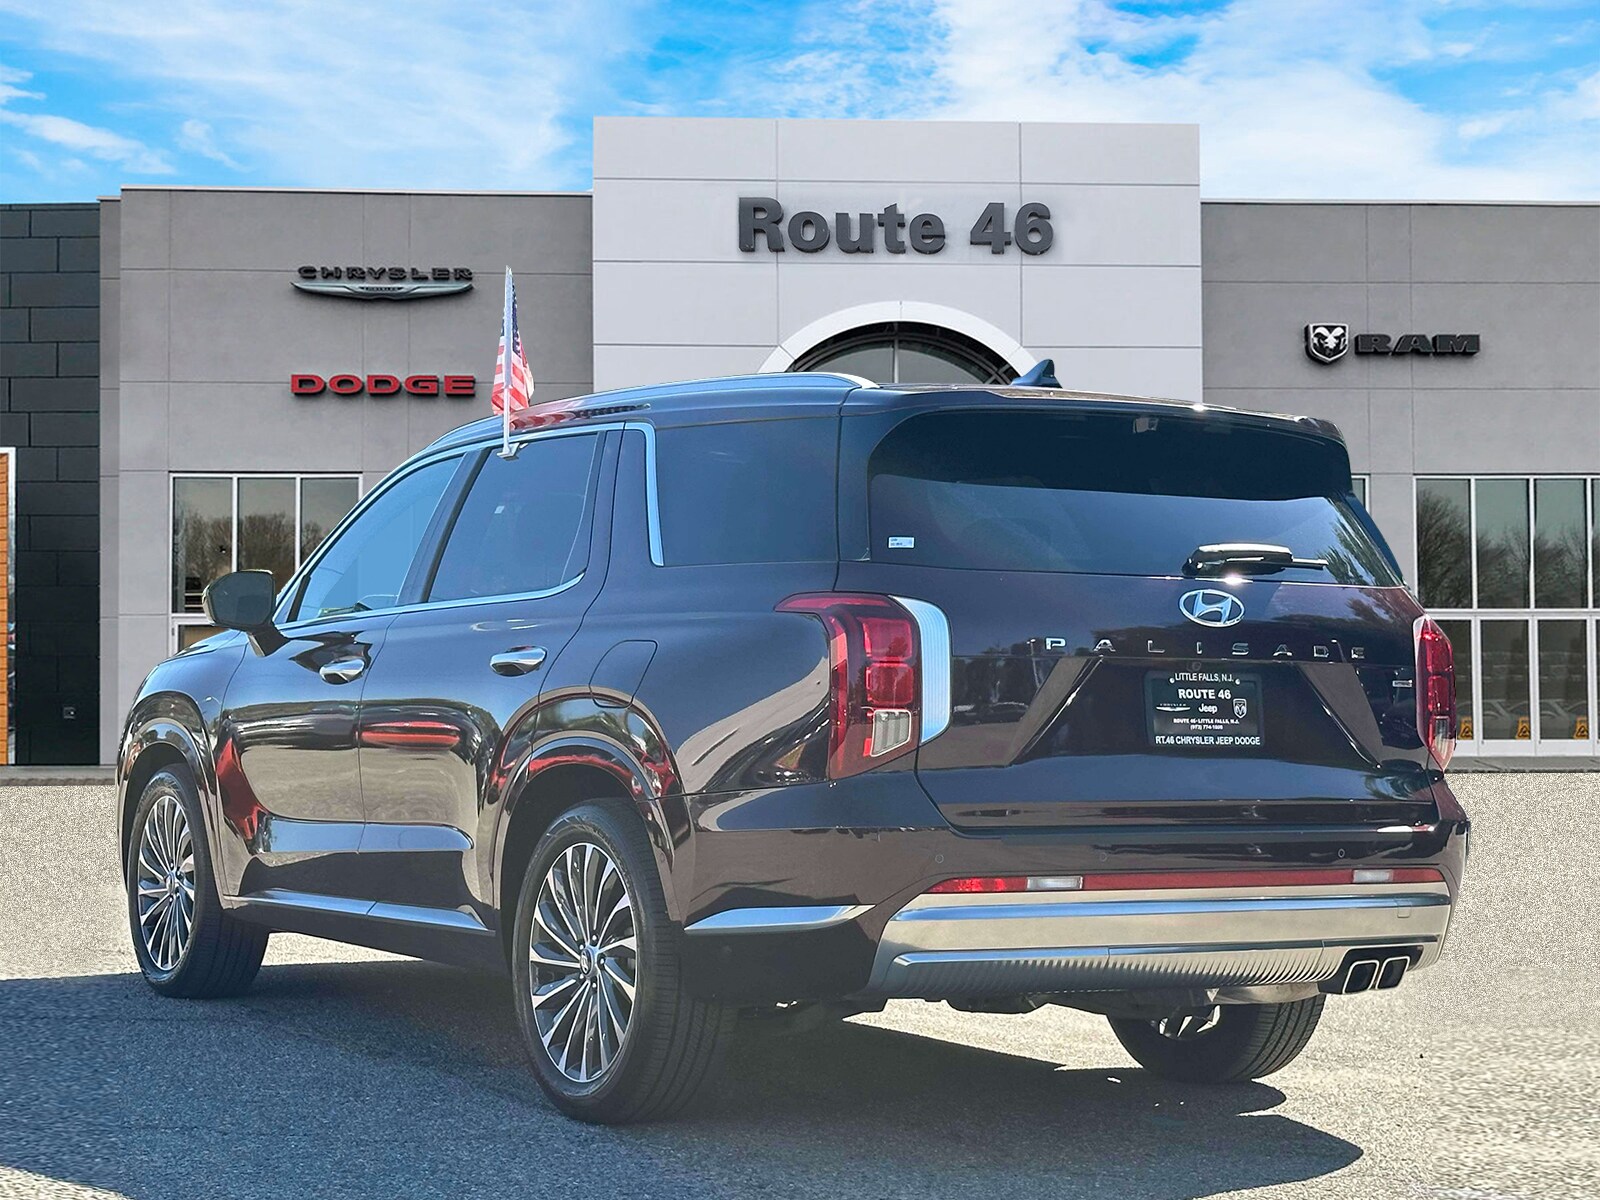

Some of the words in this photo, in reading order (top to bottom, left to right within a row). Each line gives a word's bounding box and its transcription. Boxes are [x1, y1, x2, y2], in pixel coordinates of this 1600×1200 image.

[738, 196, 946, 254] Route
[969, 201, 1054, 255] 46
[298, 266, 473, 280] CHRYSLER
[1354, 333, 1480, 354] RAM
[290, 374, 476, 396] DODGE
[1045, 637, 1366, 660] PALISADE
[1174, 672, 1197, 681] LITTLE
[1198, 673, 1221, 682] FALLS,
[1178, 689, 1216, 699] ROUTE
[1217, 689, 1231, 699] 46
[1198, 703, 1218, 714] Jeep
[1175, 736, 1215, 746] CHRYSLER
[1215, 736, 1234, 746] JEEP
[1234, 736, 1261, 746] DODGE
